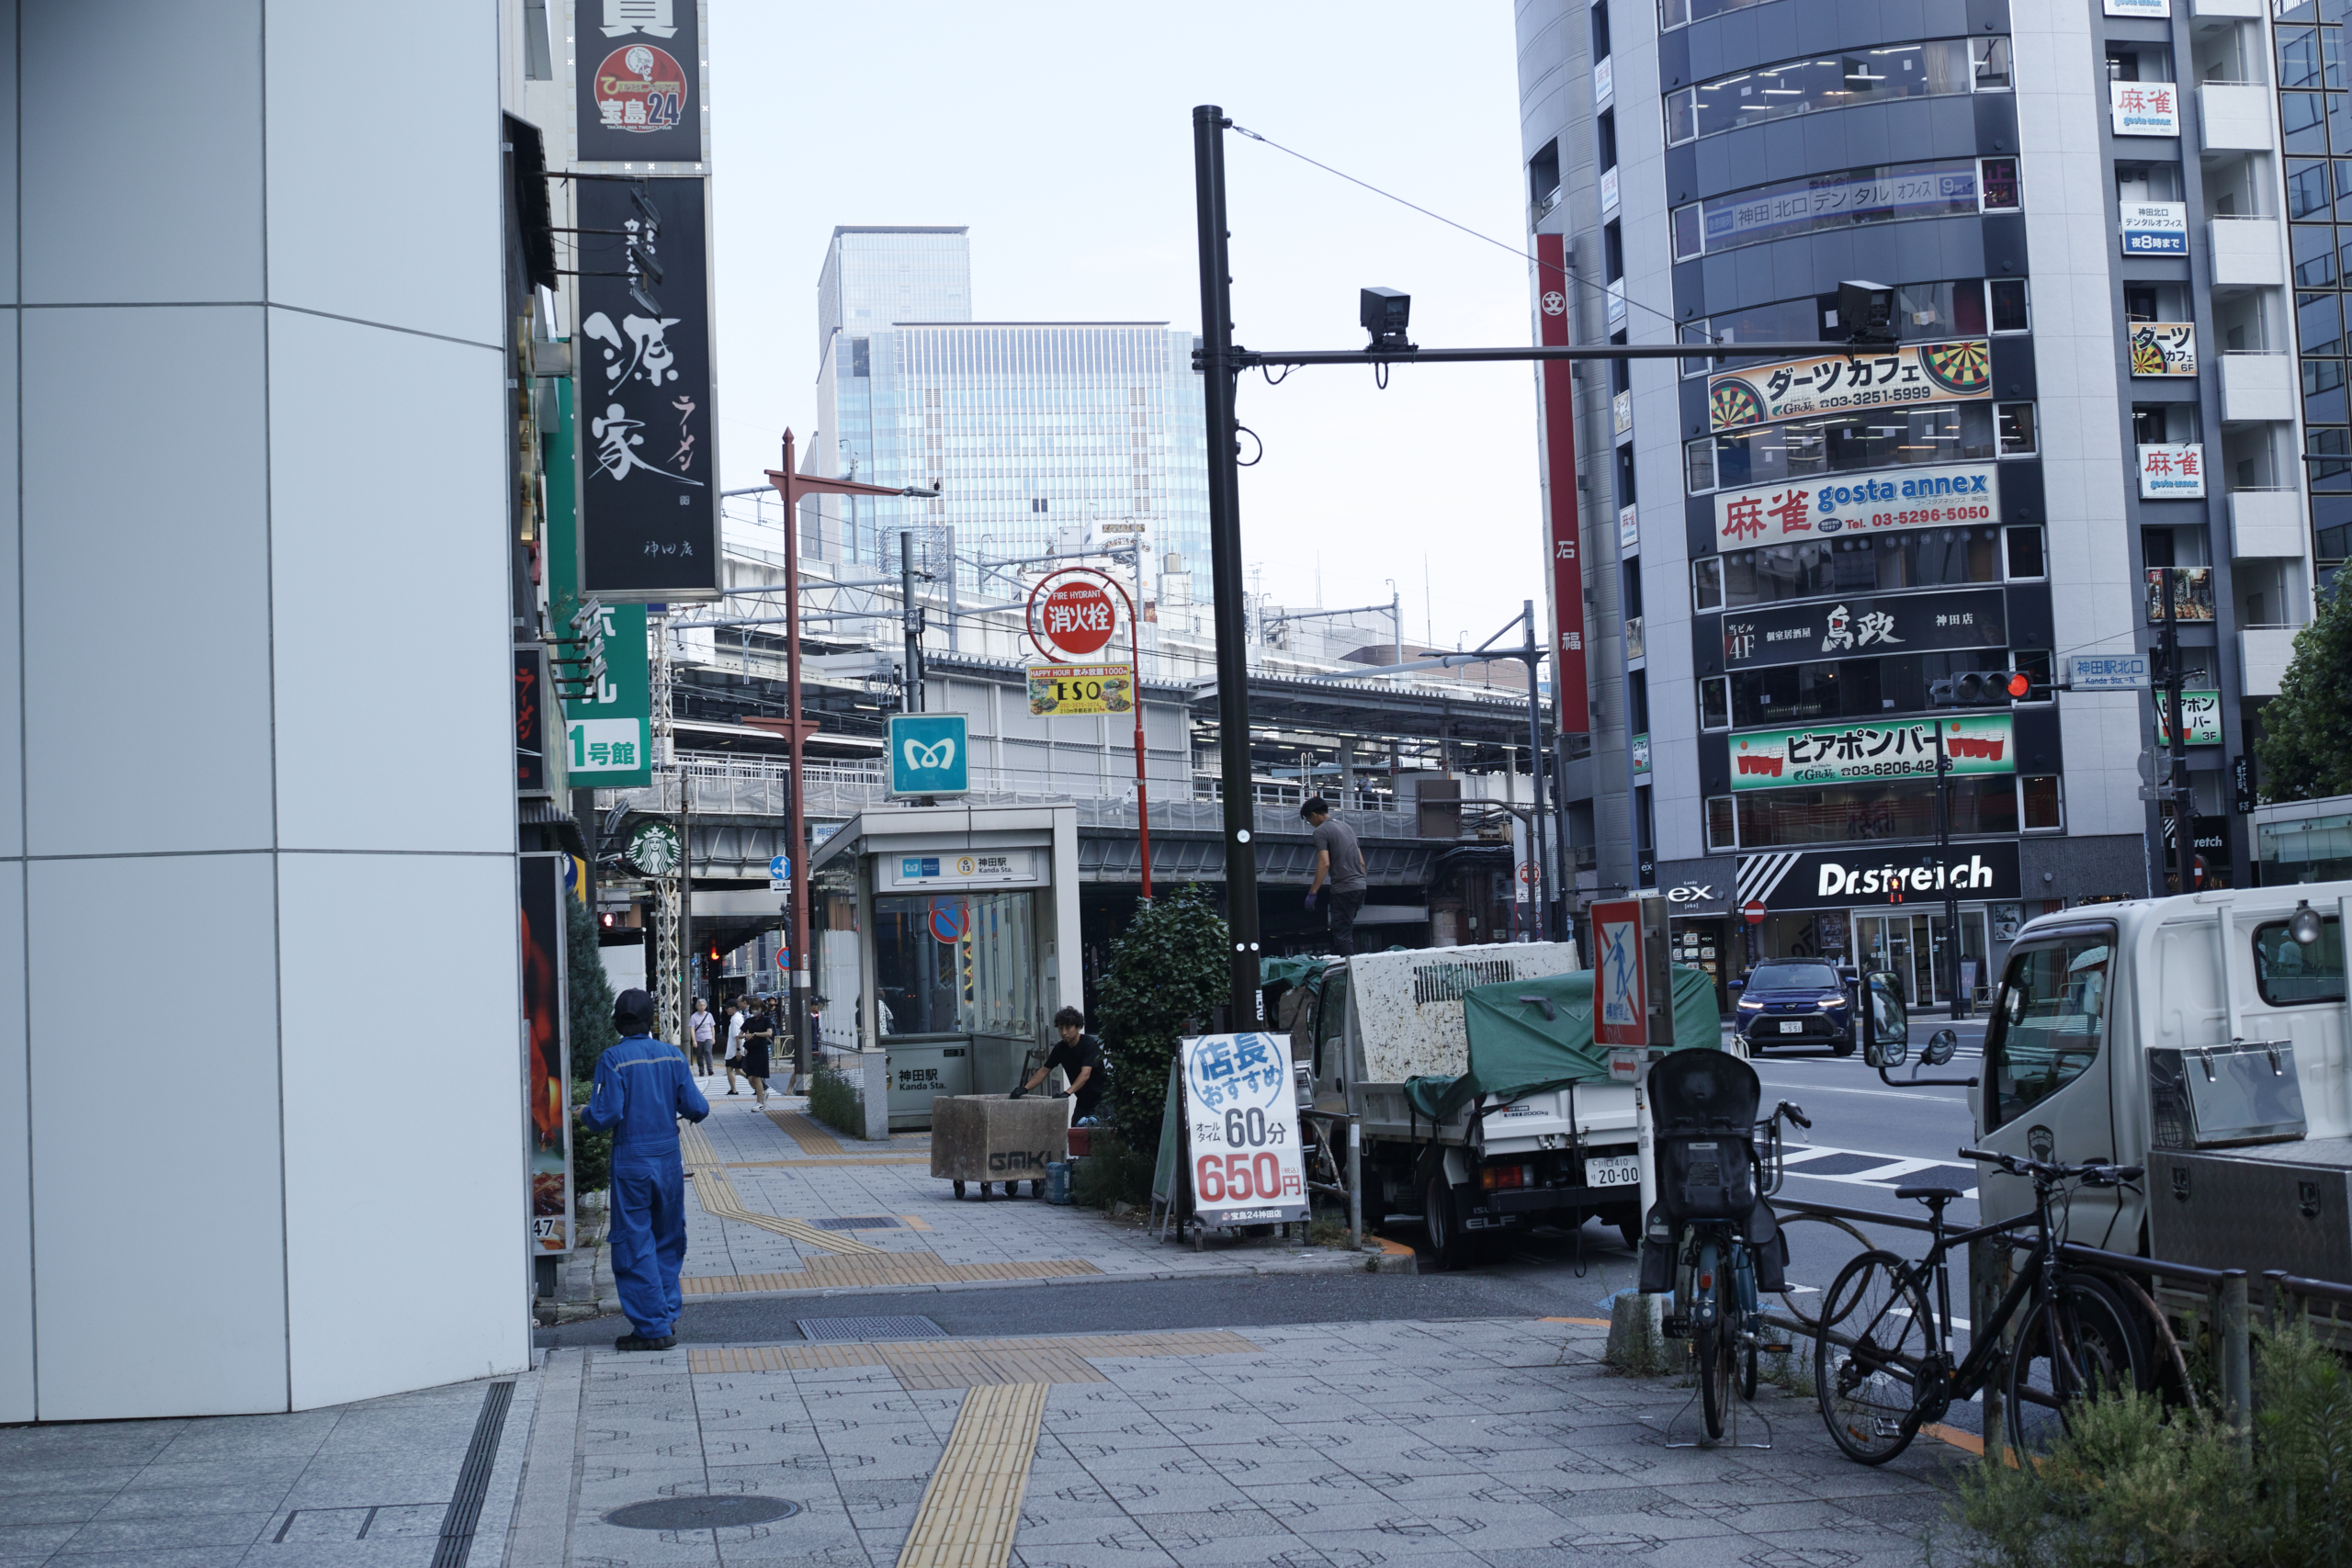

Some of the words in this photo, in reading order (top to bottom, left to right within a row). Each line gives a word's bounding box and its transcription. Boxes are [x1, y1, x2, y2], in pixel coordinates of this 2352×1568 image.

[600, 92, 680, 125] 宝島24
[2119, 88, 2172, 114] 麻雀
[2138, 208, 2168, 217] 神田北口
[2126, 219, 2183, 227] デンタルオフィス
[2132, 235, 2180, 249] 夜8時まで
[2137, 326, 2191, 349] ダーツ
[2165, 350, 2193, 362] カフェ
[2181, 364, 2194, 372] 6F
[1830, 386, 1930, 407] 03-3251-5999
[667, 396, 695, 471] ラーメン
[2144, 450, 2199, 476] 麻雀
[1817, 478, 1895, 513] gosta
[1901, 475, 1988, 498] annex
[1722, 489, 1812, 541] 麻雀
[1846, 519, 1867, 530] Tel.
[1872, 505, 1990, 527] 03-5296-5050
[643, 540, 694, 558] 神田店
[1053, 592, 1069, 600] FIRE
[1070, 590, 1101, 599] HYDRANT
[1048, 603, 1110, 633] 消火栓
[1936, 613, 1973, 626] 神田店
[1728, 623, 1755, 636] 当ビル
[1767, 627, 1812, 642] 個室居酒屋
[1729, 635, 1755, 660] 4F
[2077, 660, 2143, 674] 神田駅北口
[2086, 676, 2108, 685] Kanda
[1057, 682, 1102, 701] ESO
[515, 668, 536, 740] ラーメン
[2192, 716, 2211, 728] バー
[1787, 725, 1938, 763] ビアポンバー
[2202, 732, 2216, 740] 3F
[569, 724, 636, 767] 1号館
[978, 858, 1007, 867] 神田駅
[1668, 886, 1715, 902] ex
[1197, 1033, 1268, 1081] 店長
[899, 1069, 938, 1082] 神田駅
[899, 1082, 928, 1091] Kanda
[930, 1081, 947, 1090] Sta.
[1202, 1064, 1283, 1107] おすすめ
[1196, 1122, 1221, 1132] オール
[1197, 1132, 1221, 1142] タイム
[1599, 1167, 1638, 1185] 20-00
[1465, 1215, 1516, 1230] ELF
